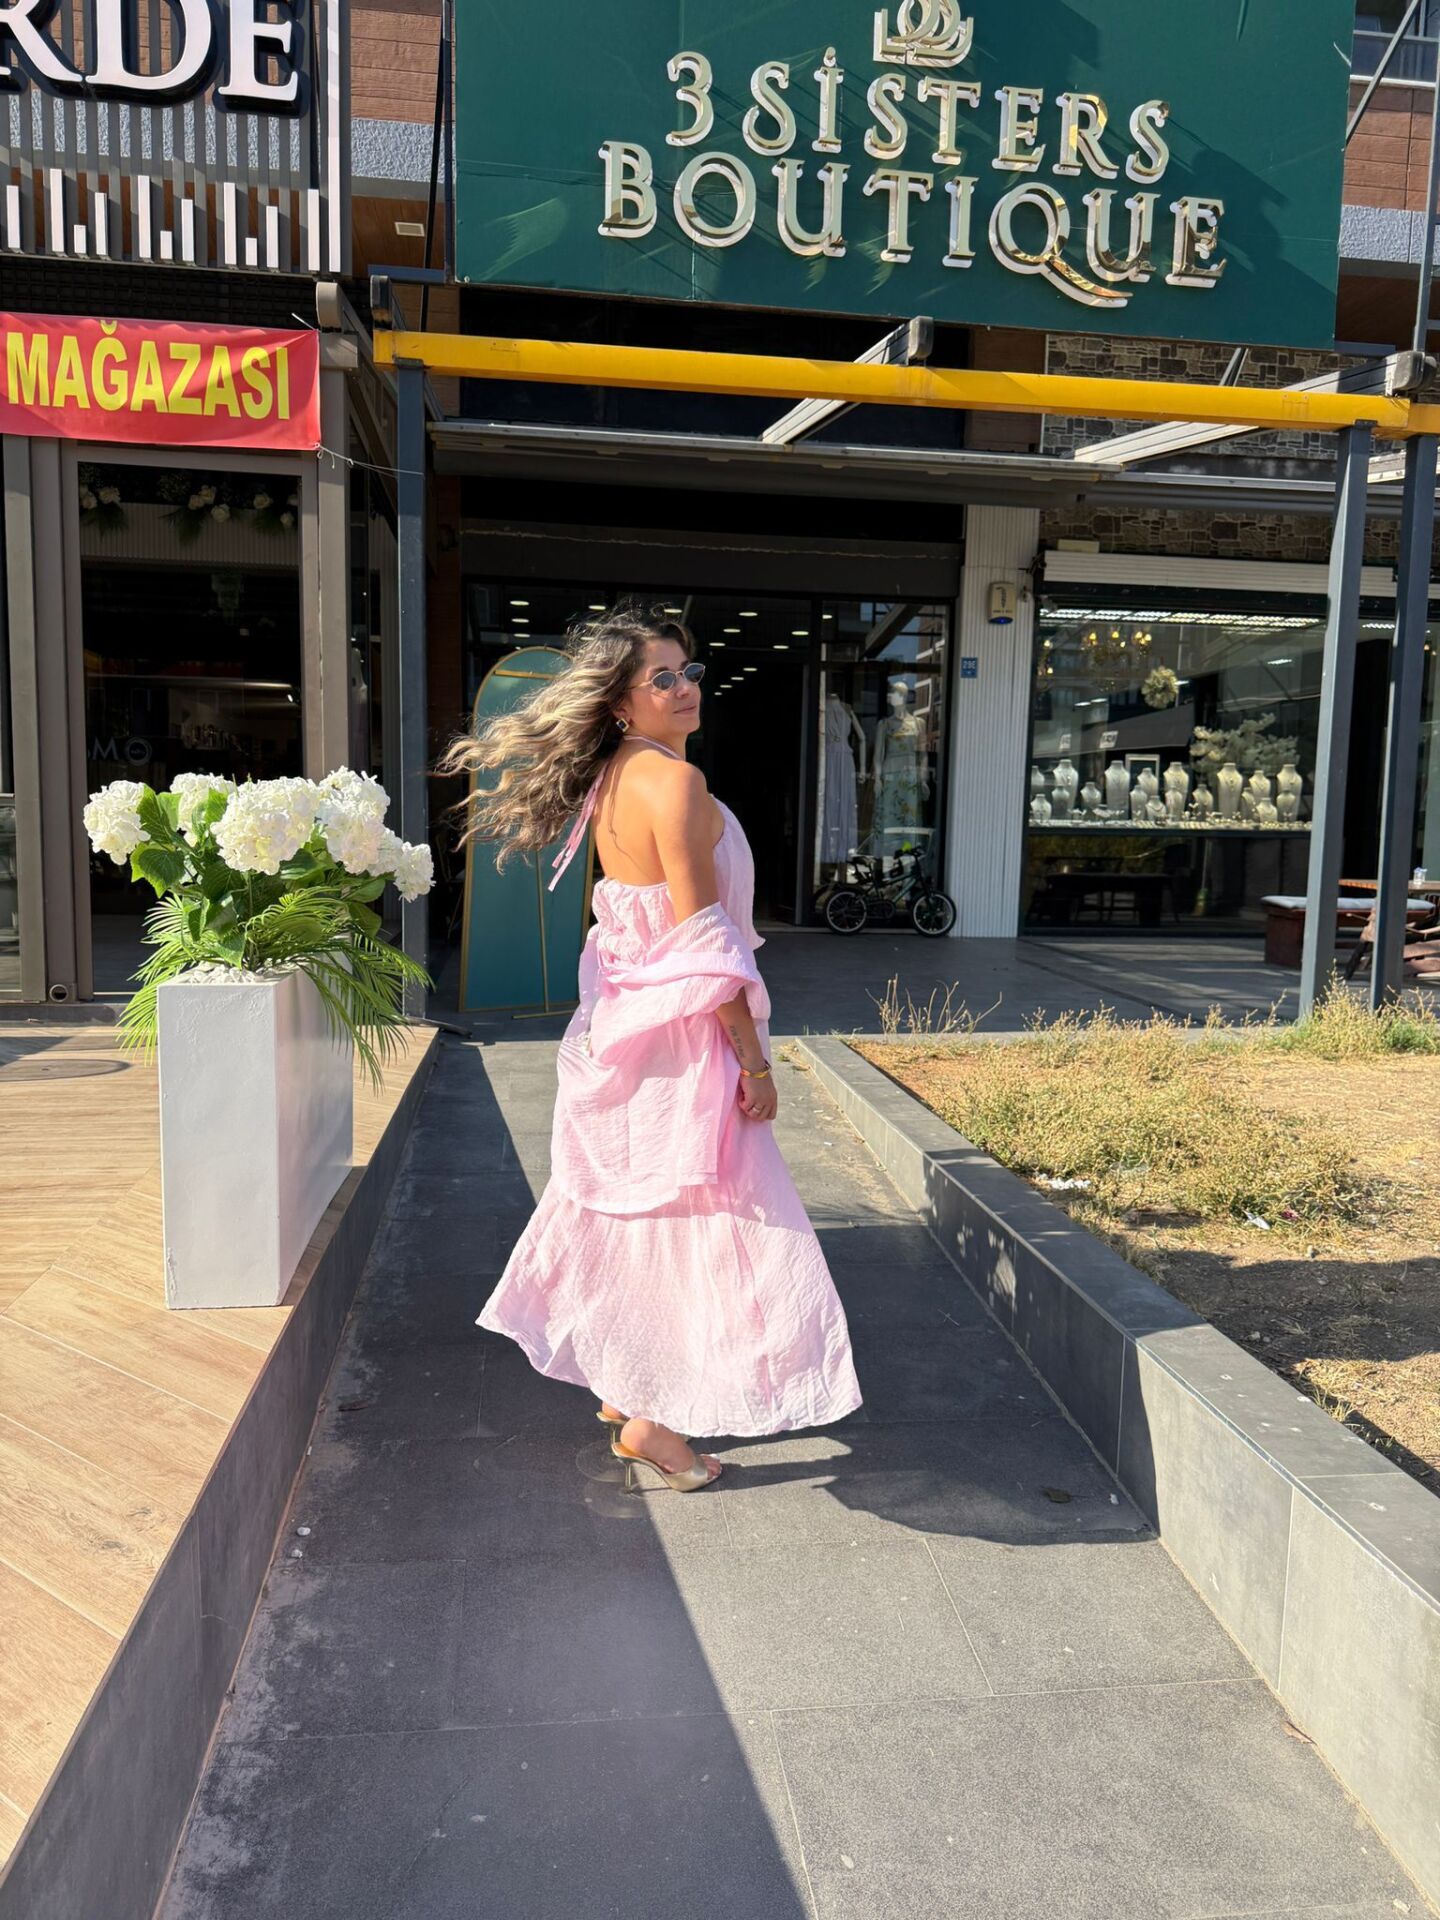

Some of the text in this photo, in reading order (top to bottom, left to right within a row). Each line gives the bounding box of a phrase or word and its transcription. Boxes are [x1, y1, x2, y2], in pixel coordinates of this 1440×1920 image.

[665, 51, 714, 147] 3
[598, 140, 1226, 308] BOUTIQUE
[6, 319, 290, 420] MAĞAZASI
